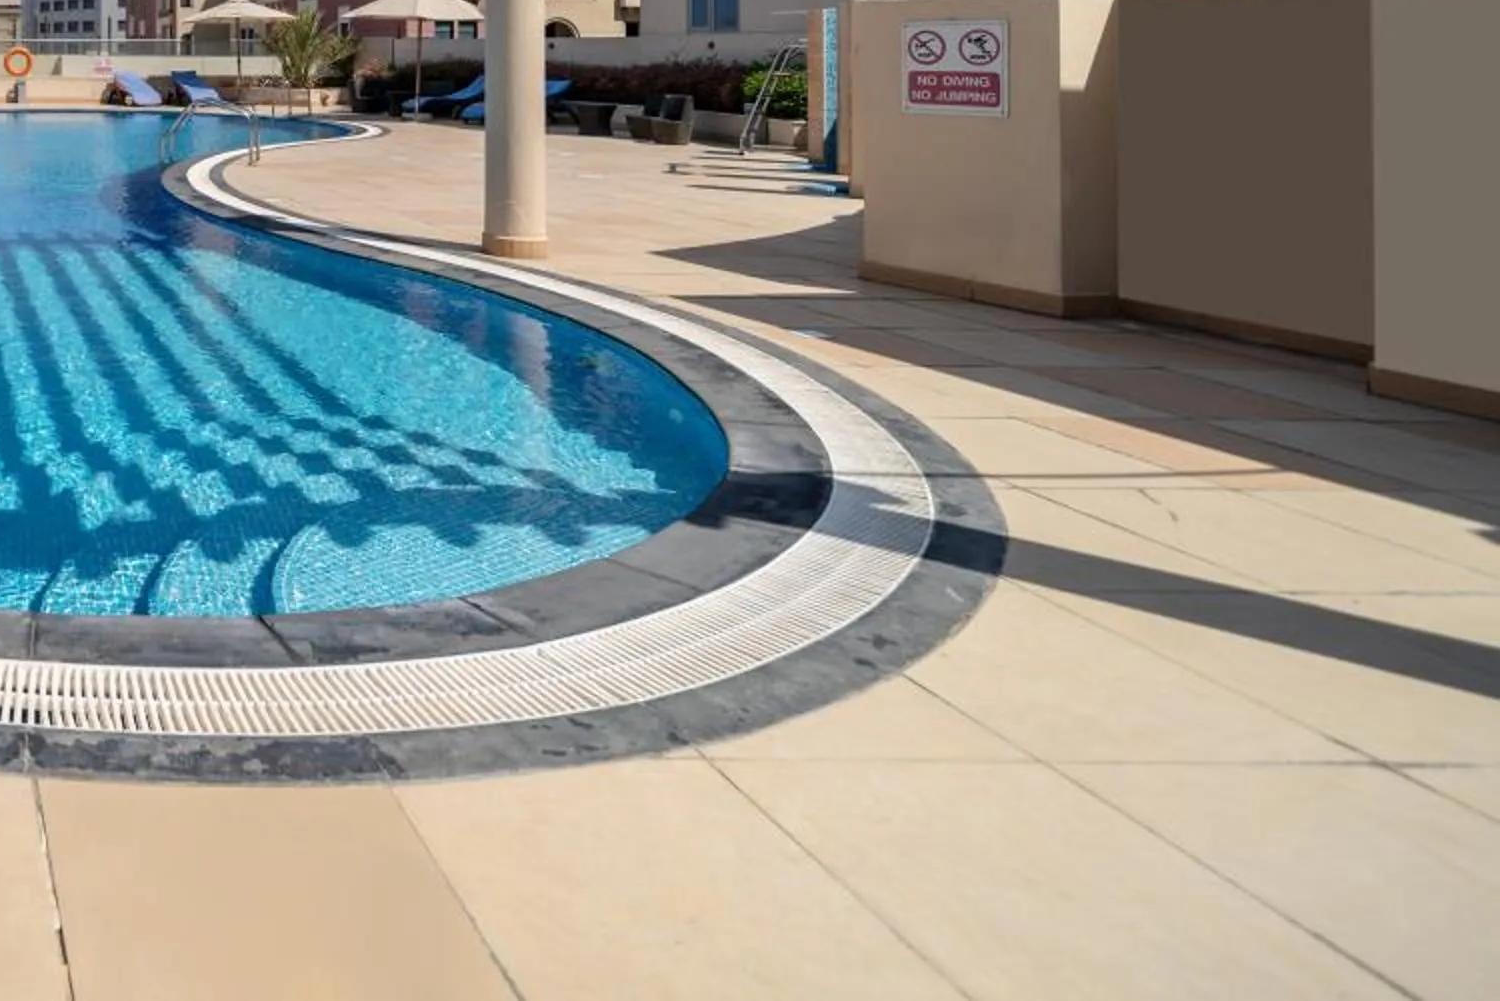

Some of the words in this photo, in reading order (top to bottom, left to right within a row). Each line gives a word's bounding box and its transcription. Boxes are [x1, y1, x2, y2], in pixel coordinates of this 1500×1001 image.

[917, 74, 937, 86] NO
[943, 75, 991, 88] DIVING
[911, 90, 931, 101] NO
[935, 90, 997, 104] JUMPING
